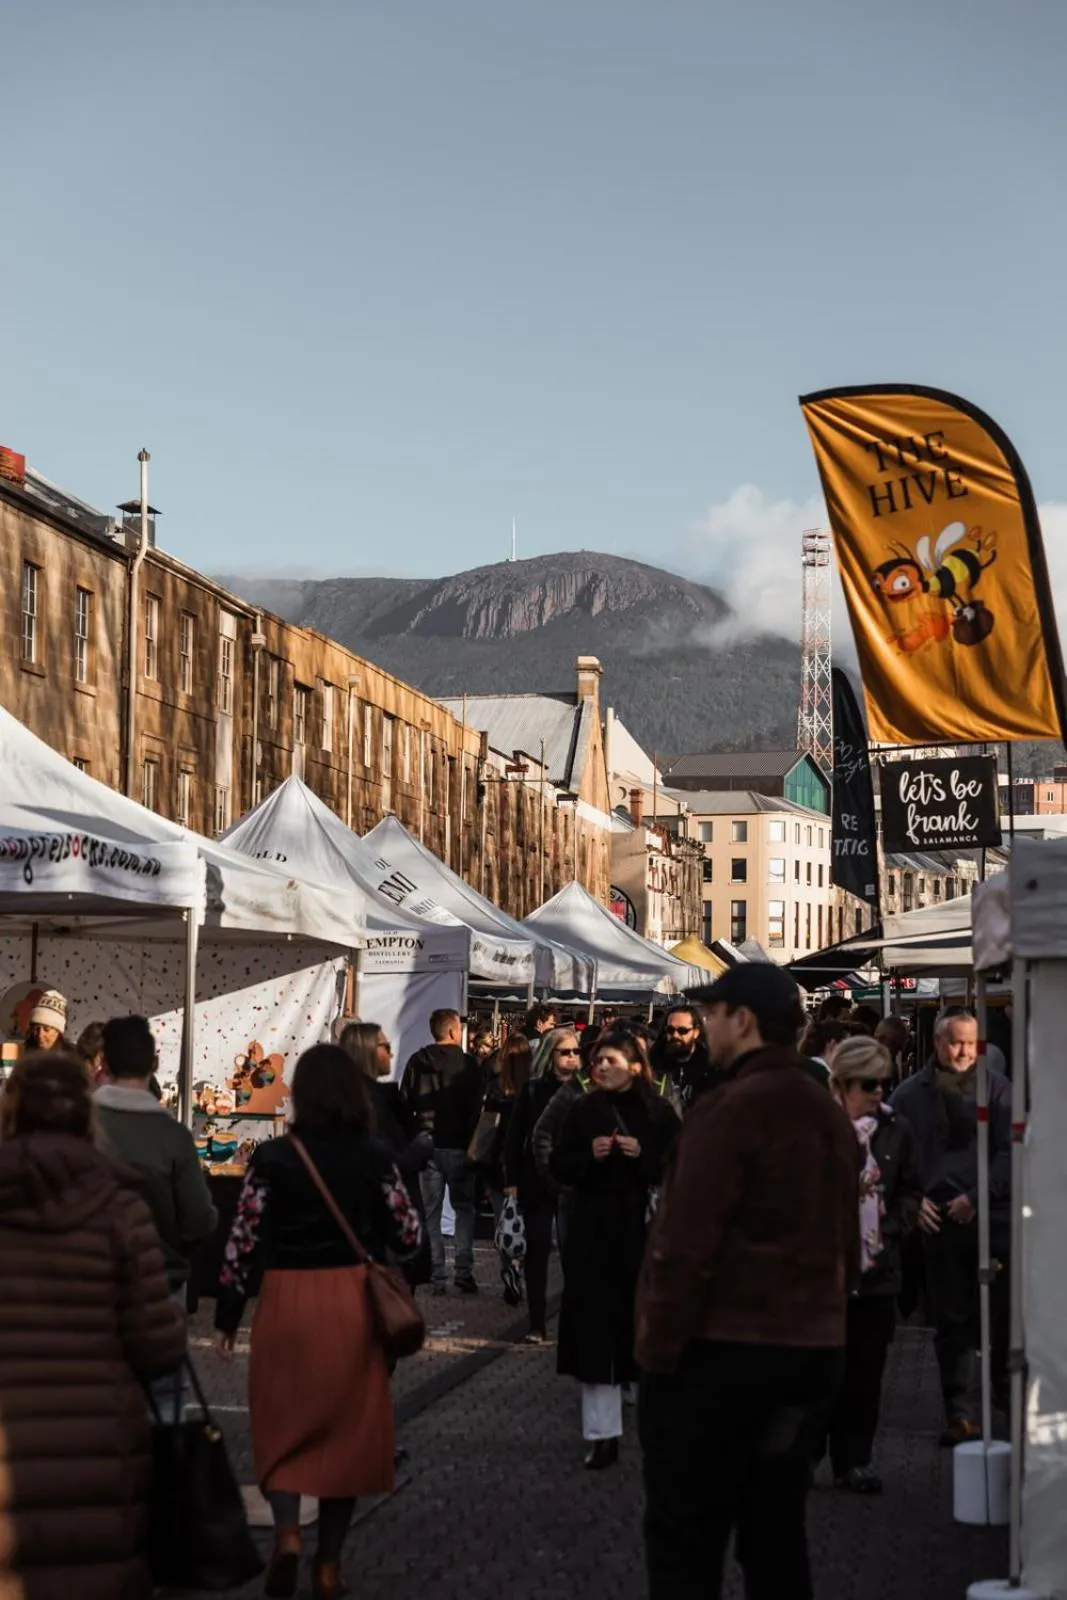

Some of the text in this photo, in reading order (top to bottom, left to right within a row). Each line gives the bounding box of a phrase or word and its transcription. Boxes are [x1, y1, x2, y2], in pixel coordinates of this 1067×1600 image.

[865, 430, 948, 472] THE
[867, 467, 968, 517] HIVE
[899, 769, 983, 805] let's be
[905, 801, 979, 845] frank
[923, 835, 978, 845] SALAMANCA
[0, 832, 161, 884] ongrelsocks.com.au
